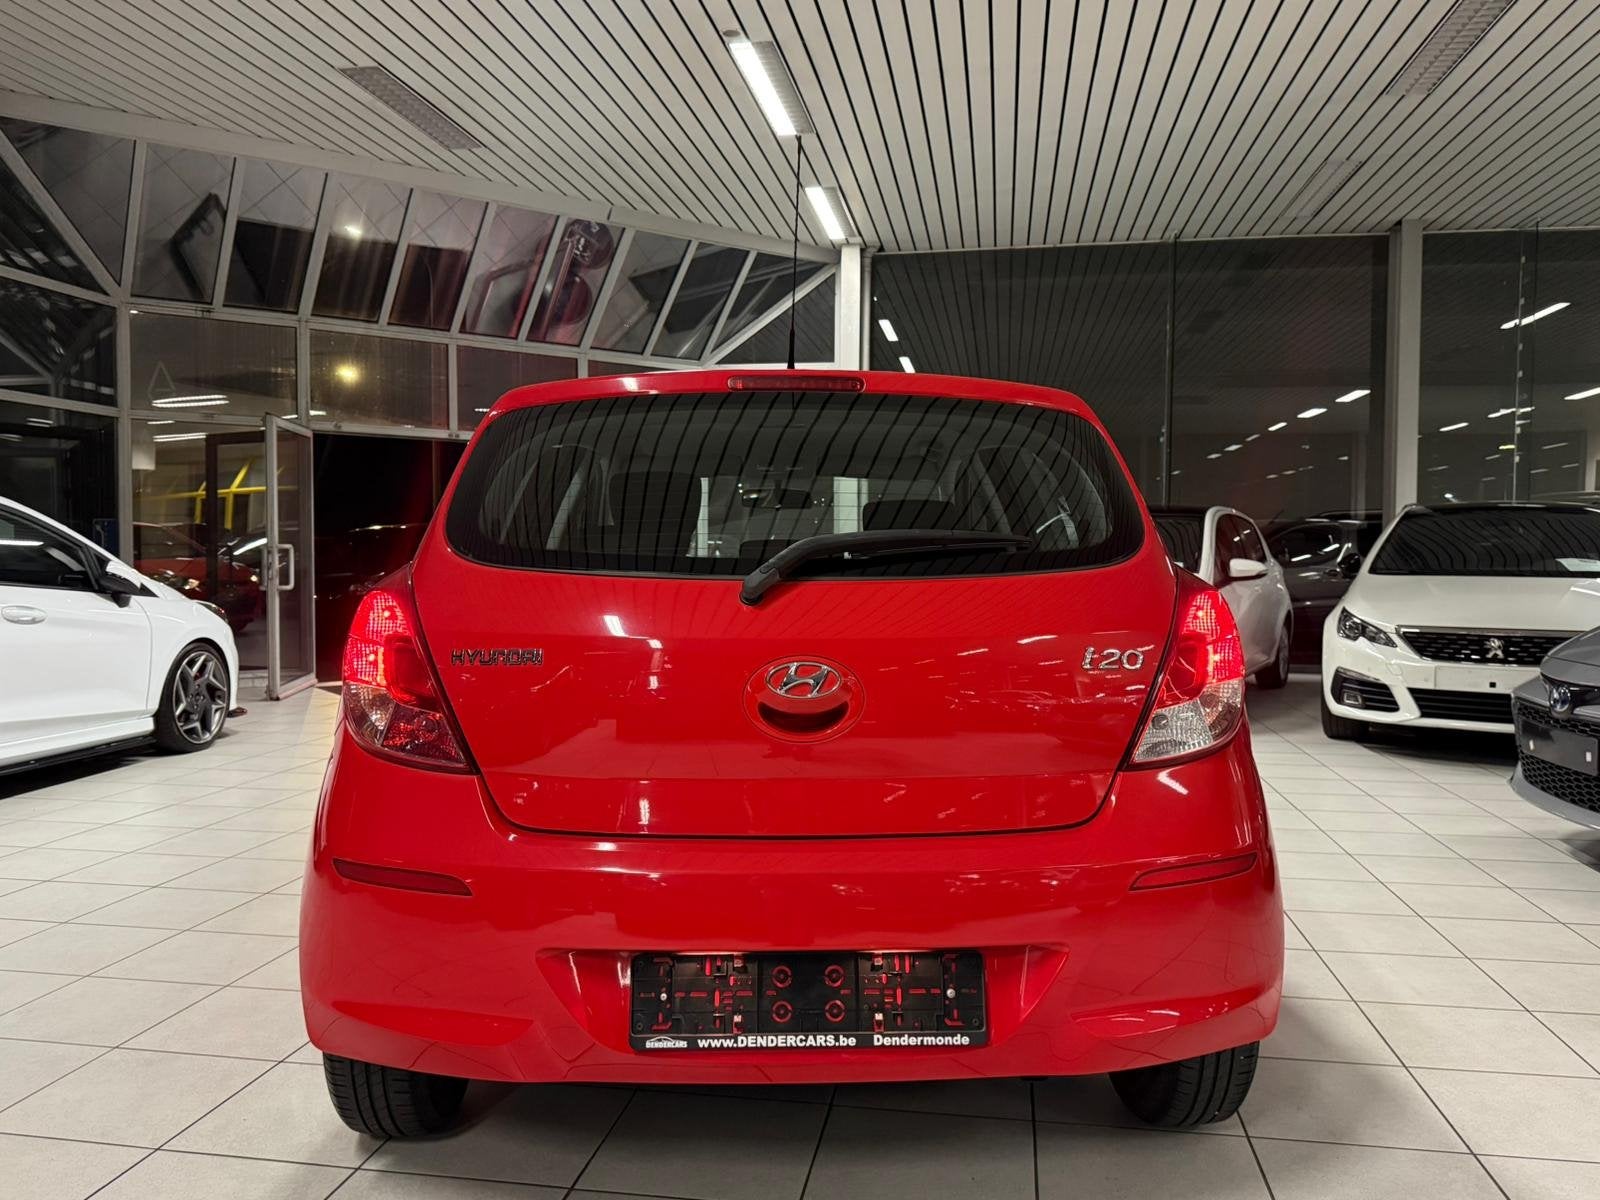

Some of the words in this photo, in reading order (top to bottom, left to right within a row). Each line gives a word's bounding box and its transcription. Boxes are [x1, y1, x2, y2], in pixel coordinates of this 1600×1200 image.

[451, 648, 543, 666] HYUNDAI
[1082, 646, 1144, 670] i20
[645, 1038, 688, 1049] DENDERCARS
[697, 1034, 857, 1048] www.DENDERCARS.be
[873, 1033, 970, 1046] Dendermonde
